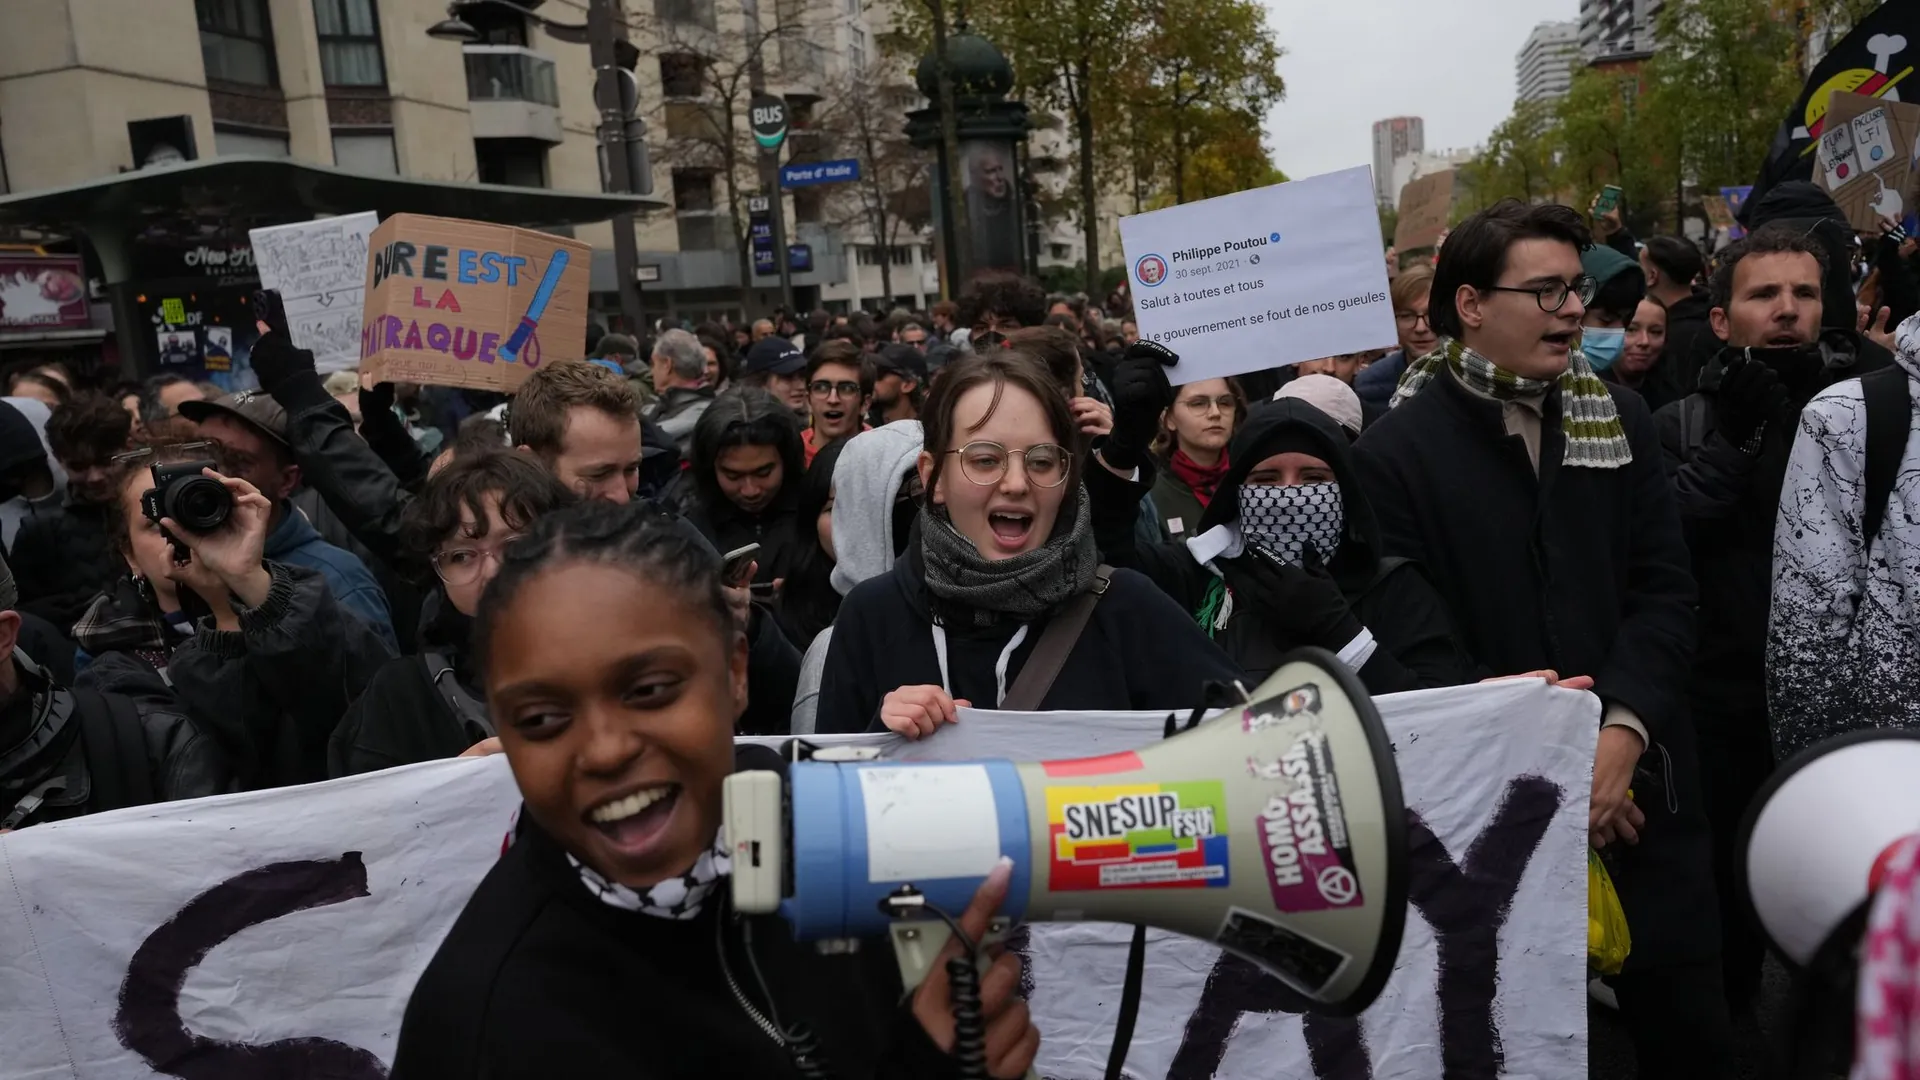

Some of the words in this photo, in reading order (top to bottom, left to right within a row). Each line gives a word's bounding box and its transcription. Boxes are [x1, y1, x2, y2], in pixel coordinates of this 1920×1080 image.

[753, 105, 783, 125] BUS
[786, 170, 813, 182] Porte
[826, 165, 851, 177] Italie
[184, 246, 227, 266] New
[1172, 244, 1221, 263] Philippe
[1224, 236, 1267, 252] Poutou
[373, 241, 448, 289] DURE
[458, 249, 527, 286] EST
[1175, 268, 1188, 279] 30
[1190, 264, 1213, 279] sept.
[1217, 259, 1240, 272] 2021
[413, 286, 462, 313] LA
[1141, 295, 1170, 310] Salut
[1174, 292, 1181, 304] à
[1184, 286, 1221, 302] toutes
[1224, 283, 1236, 295] et
[1239, 278, 1264, 292] tous
[1147, 332, 1161, 343] Le
[1164, 316, 1247, 342] gouvernement
[1250, 313, 1264, 325] se
[1267, 308, 1291, 322] fout
[1295, 302, 1310, 317] de
[1313, 300, 1335, 314] nos
[1338, 291, 1386, 311] gueules
[361, 314, 500, 364] MATRAQUE
[150, 497, 158, 517] SONY
[1066, 795, 1175, 838] SNESUP
